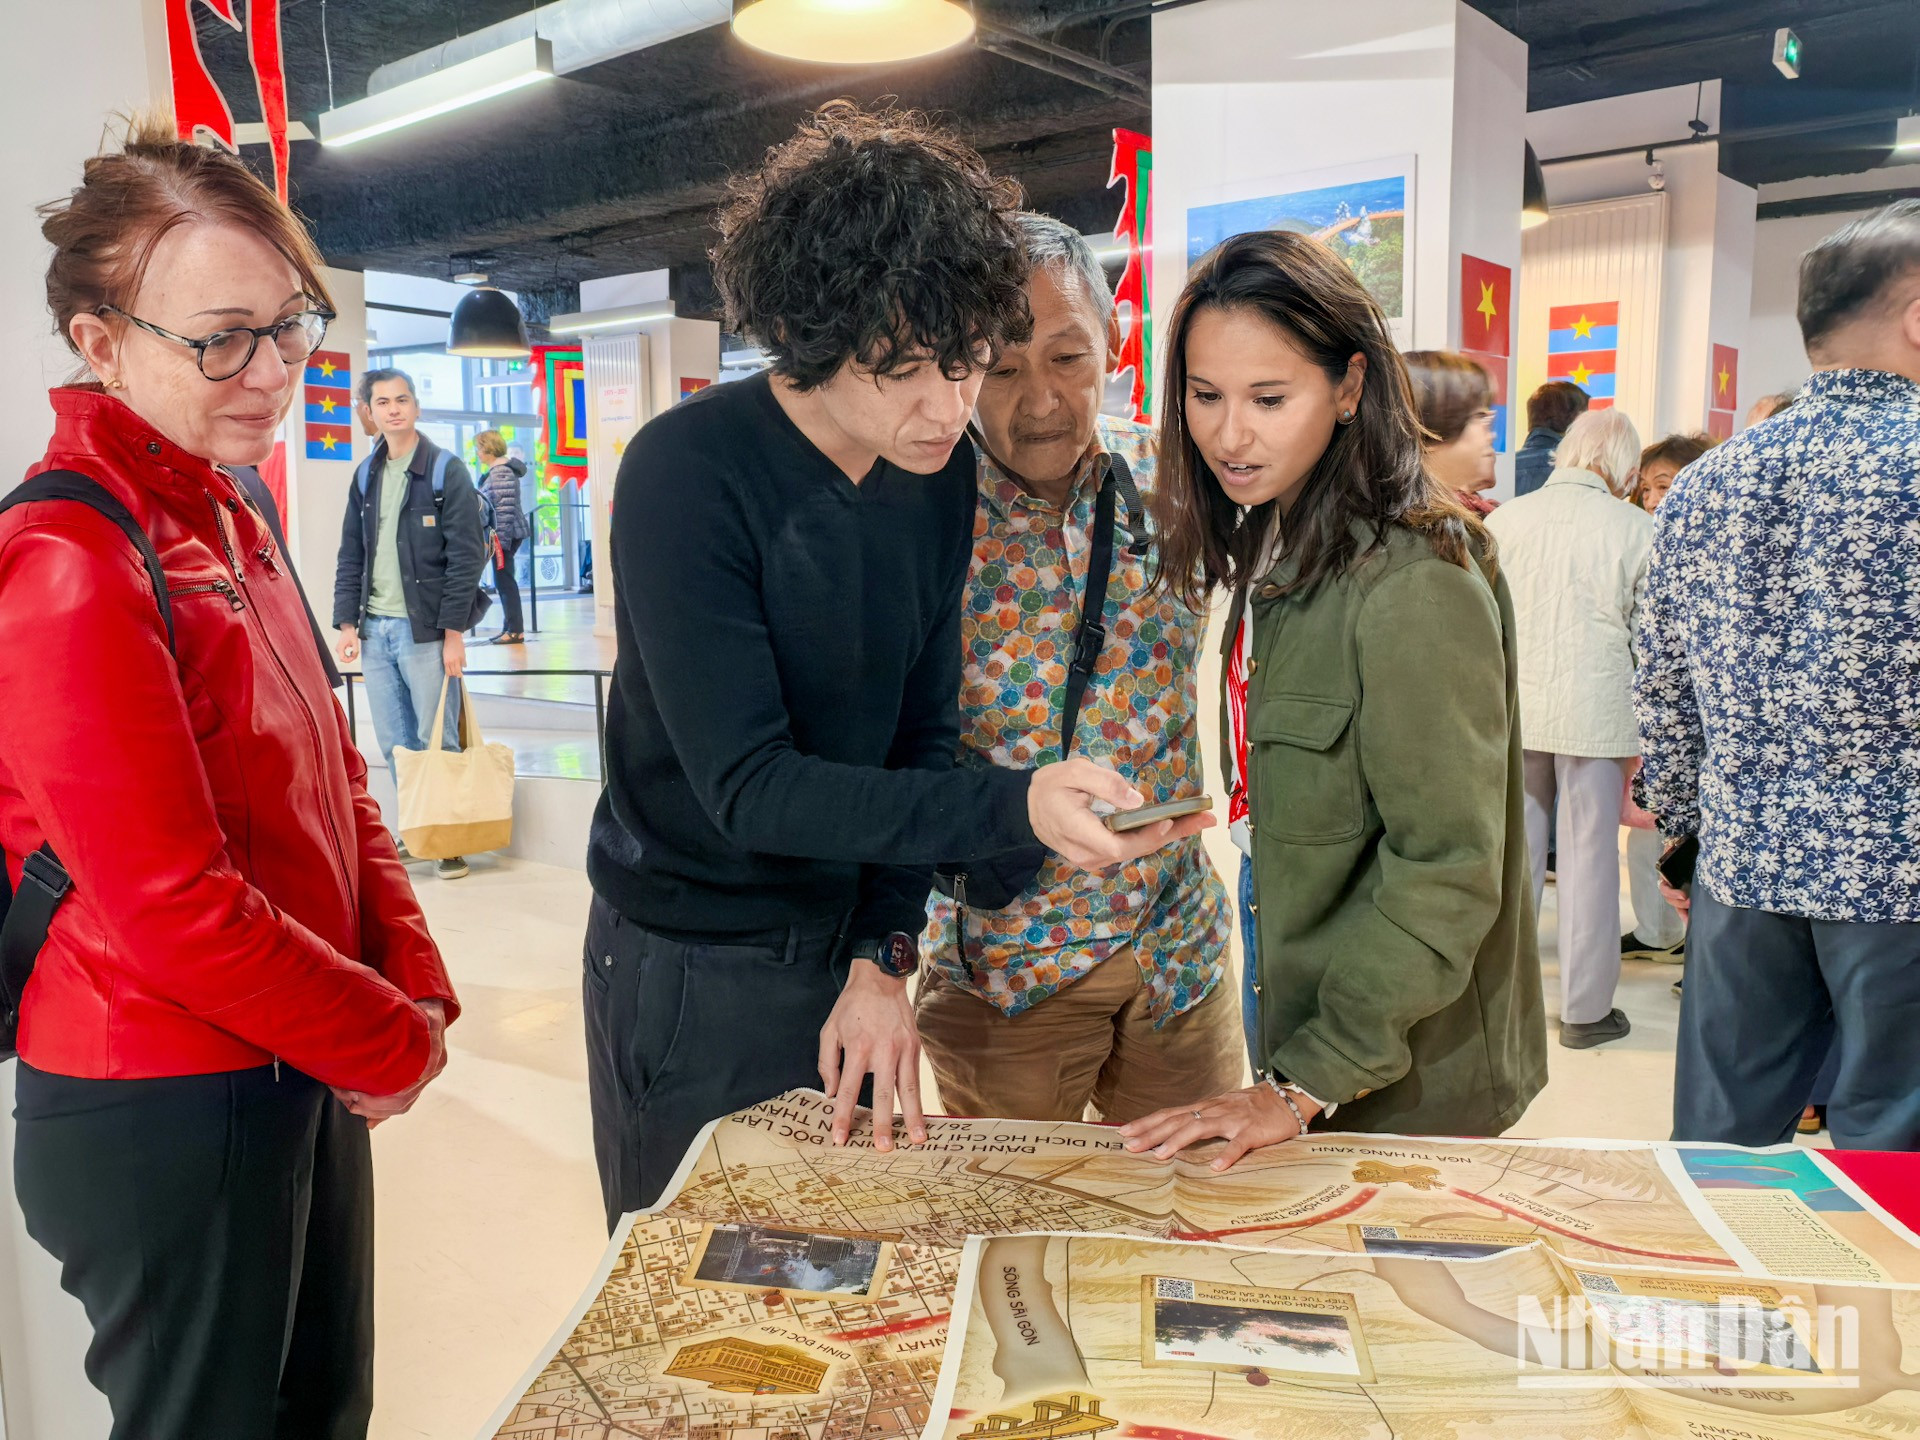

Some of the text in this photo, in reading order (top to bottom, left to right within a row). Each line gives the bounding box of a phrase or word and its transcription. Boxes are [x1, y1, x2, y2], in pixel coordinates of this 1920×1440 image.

[818, 1120, 873, 1137] TON
[972, 1144, 1036, 1156] ĐÁNH
[1772, 1194, 1792, 1202] 15
[1003, 1266, 1021, 1299] SÔNG
[816, 1344, 852, 1361] DINH
